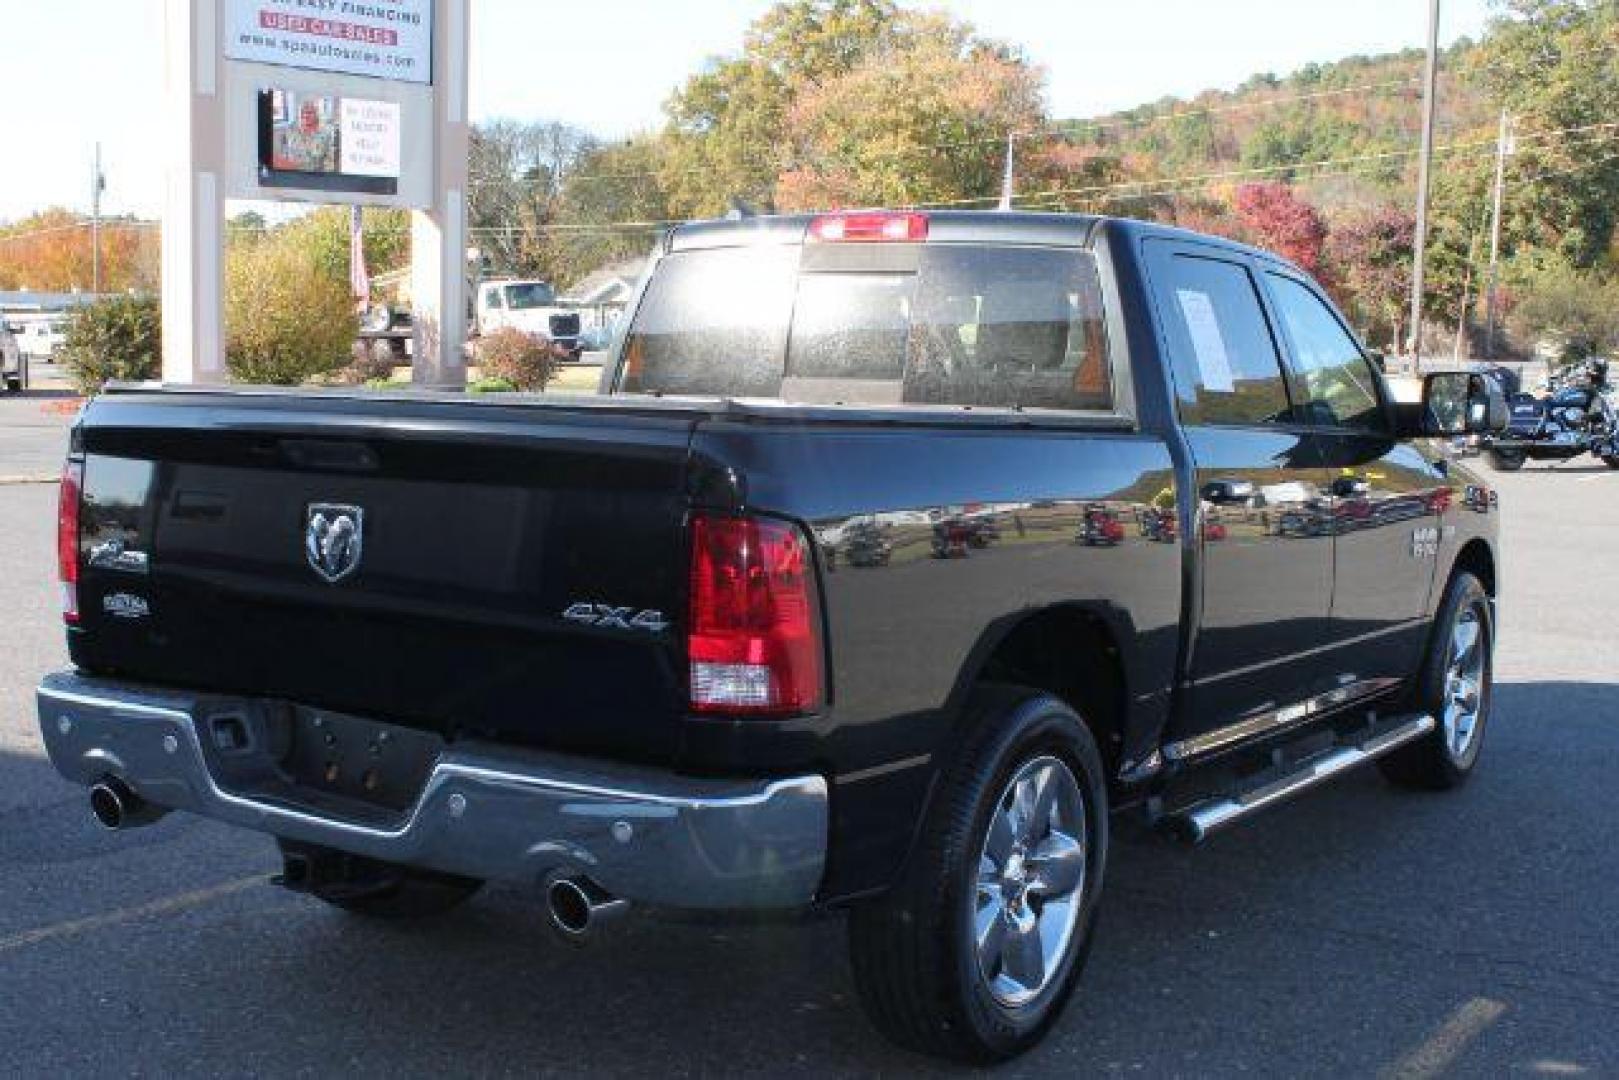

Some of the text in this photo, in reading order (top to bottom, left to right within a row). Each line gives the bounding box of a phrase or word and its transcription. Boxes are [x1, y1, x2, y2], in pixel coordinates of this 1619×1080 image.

[341, 2, 421, 25] FINANCING
[264, 12, 307, 31] USED
[346, 23, 392, 44] SALES
